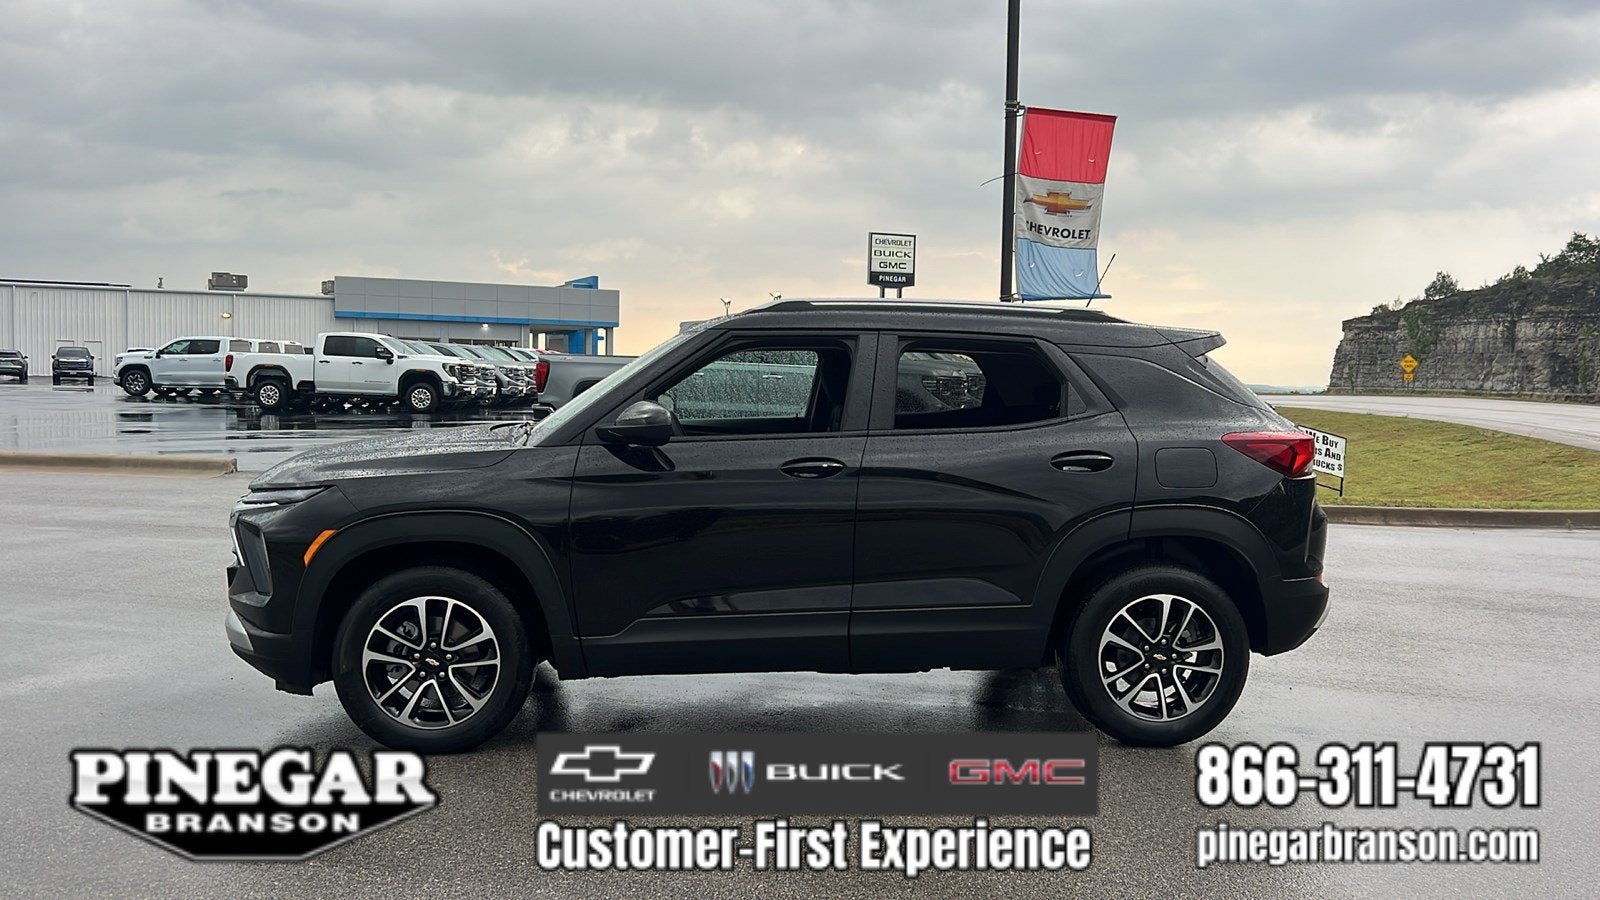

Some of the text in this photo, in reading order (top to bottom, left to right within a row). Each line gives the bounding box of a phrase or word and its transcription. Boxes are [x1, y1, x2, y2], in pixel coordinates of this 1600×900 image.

[874, 238, 912, 247] CHEVROLET
[873, 249, 912, 258] BUICK
[878, 261, 907, 270] GMC
[878, 275, 907, 283] PINEGAR
[1322, 435, 1339, 448] BUY
[1324, 447, 1341, 461] AND
